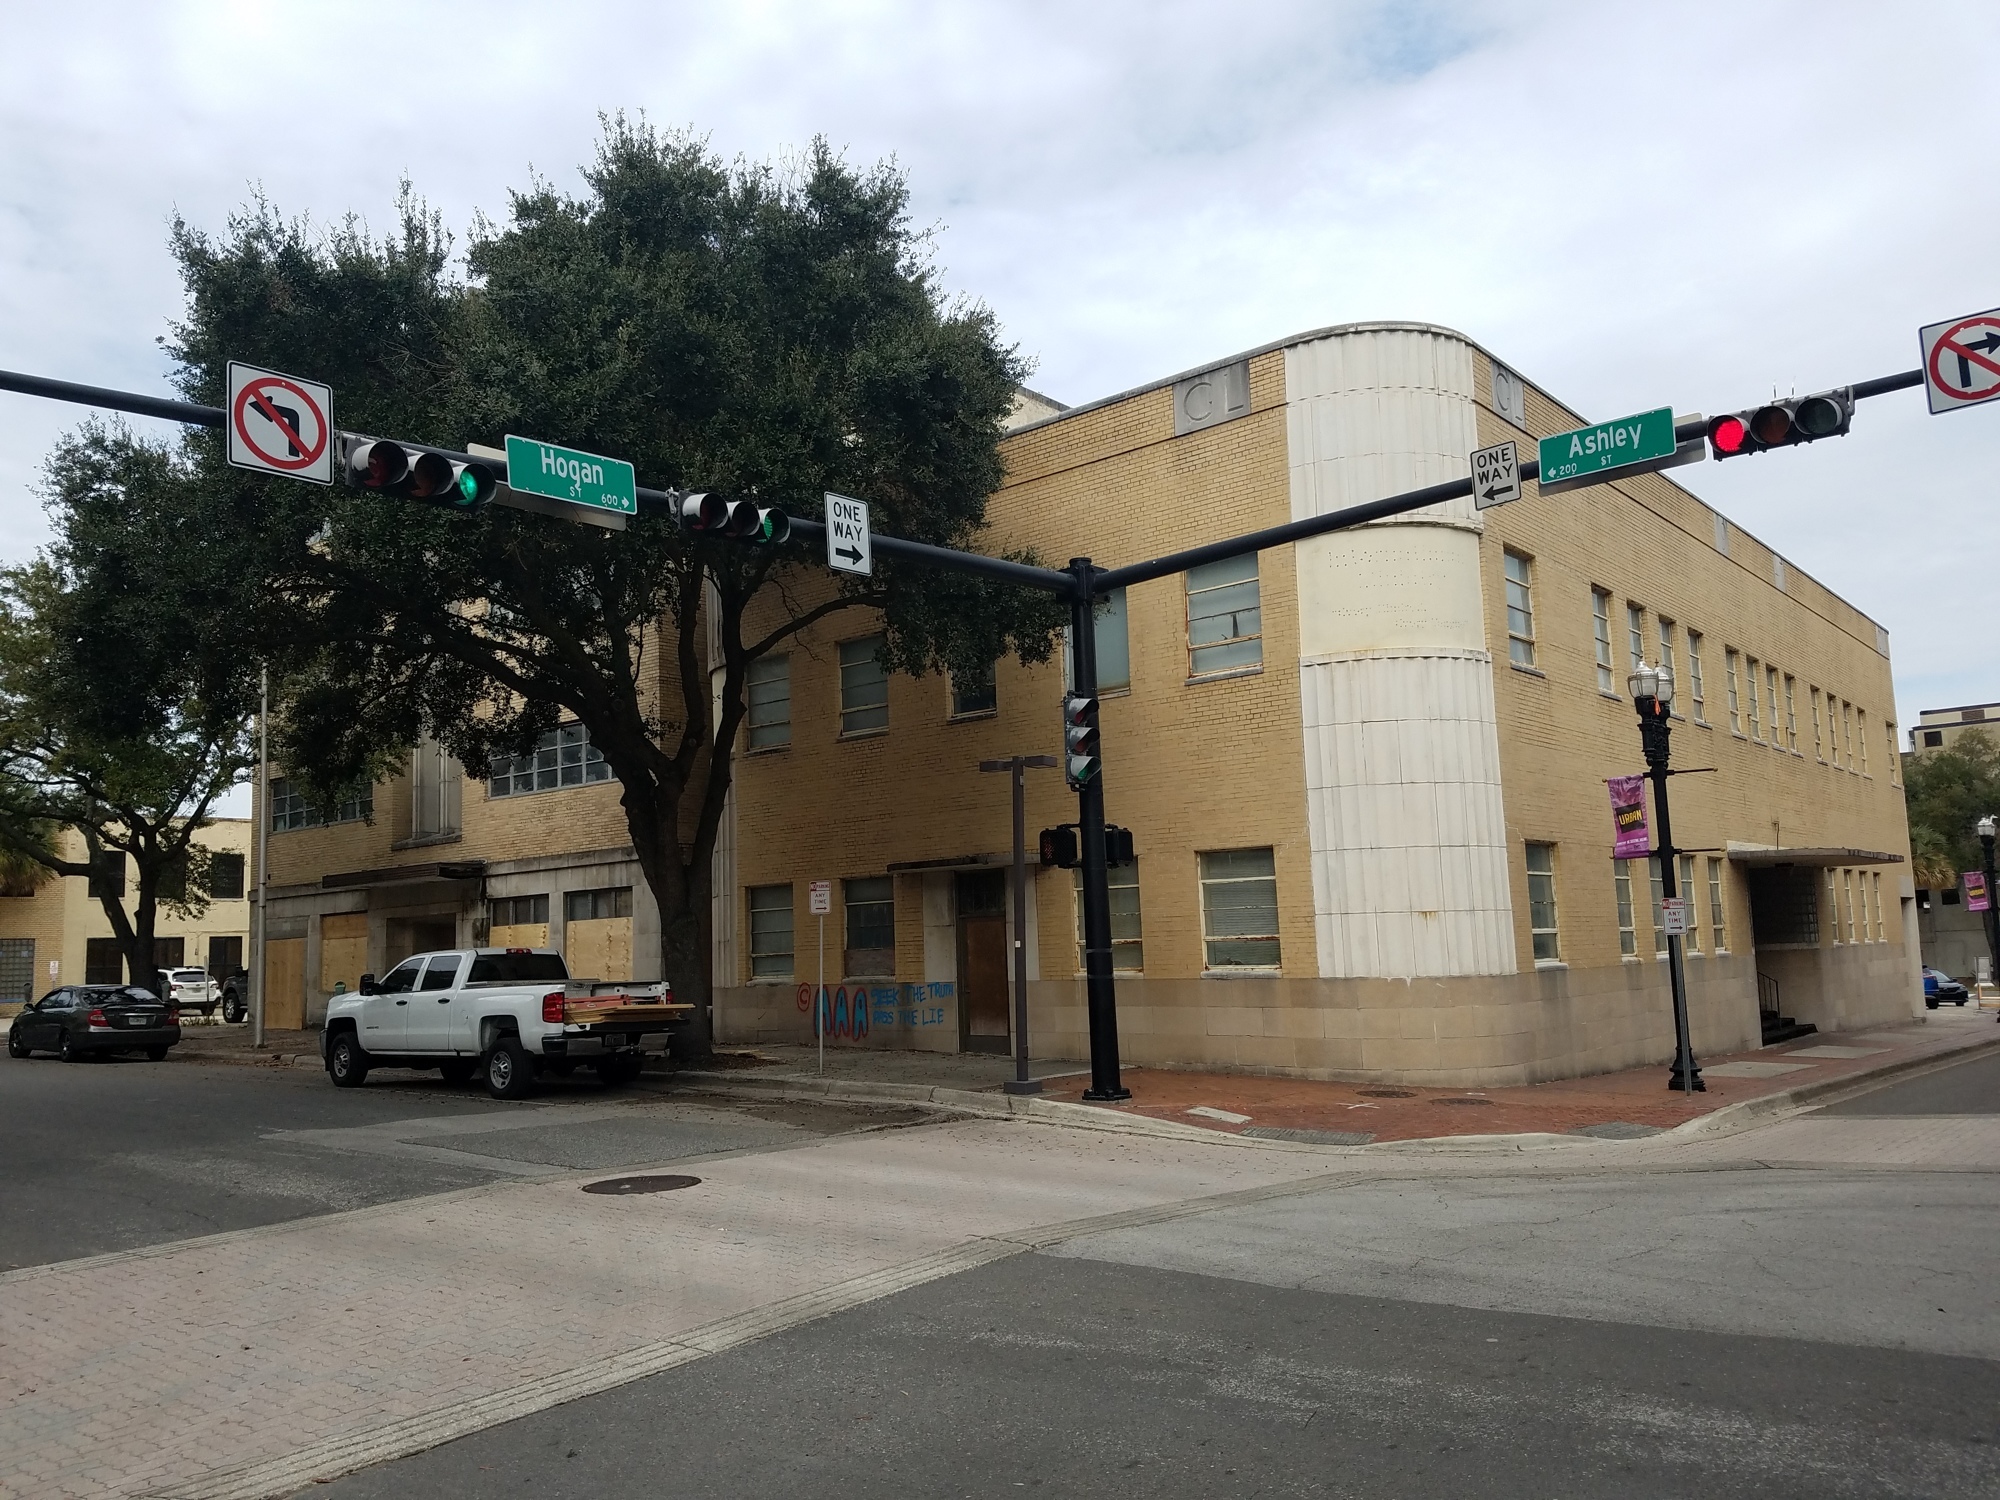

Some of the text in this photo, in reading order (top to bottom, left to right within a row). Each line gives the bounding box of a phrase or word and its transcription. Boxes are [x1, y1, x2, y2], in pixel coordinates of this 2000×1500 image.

[1568, 423, 1642, 459] Ashley
[540, 446, 604, 491] Hogan
[1476, 447, 1511, 469] ONE
[1559, 454, 1612, 476] 200 ST
[1477, 463, 1514, 486] WAY
[569, 485, 618, 506] ST 600
[833, 501, 862, 523] ONE
[833, 520, 863, 542] WAY
[1618, 809, 1643, 826] URBAN
[904, 984, 926, 1005] THE
[926, 982, 954, 1000] TRUTH
[898, 1008, 918, 1026] THE
[922, 1008, 944, 1026] LIE
